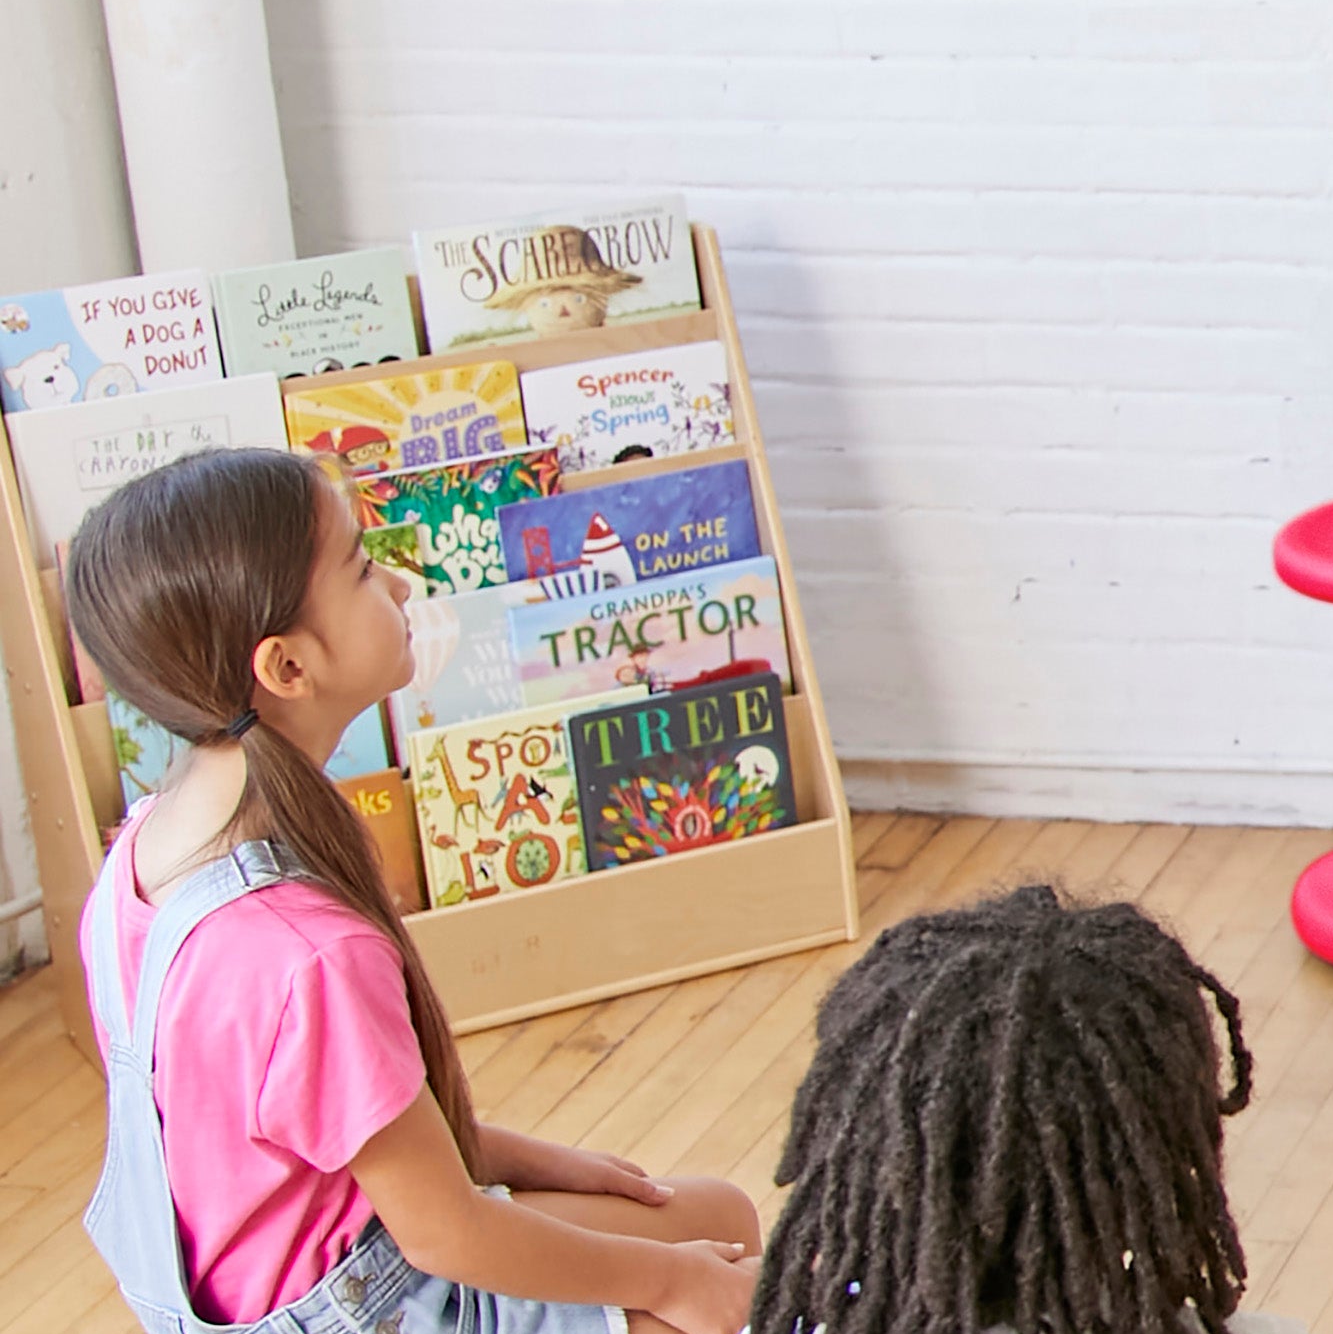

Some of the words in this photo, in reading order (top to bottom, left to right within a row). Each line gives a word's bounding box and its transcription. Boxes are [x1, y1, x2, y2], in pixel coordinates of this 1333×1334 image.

[434, 240, 471, 267] THE
[460, 215, 674, 302] SCARECROW
[82, 299, 101, 323] IF
[108, 295, 146, 317] YOU
[152, 288, 201, 310] GIVE
[313, 270, 382, 312] Legends
[125, 328, 136, 349] A
[142, 321, 185, 344] DOG
[193, 317, 203, 339] A
[144, 345, 207, 375] DONUT
[577, 368, 674, 398] Spencer
[411, 401, 477, 433] Dream
[591, 403, 670, 437] Spring
[401, 414, 505, 468] BIG
[635, 531, 669, 552] ON
[680, 517, 728, 544] THE
[639, 543, 730, 576] LAUNCH
[590, 582, 707, 621] GRANDPA'S
[539, 594, 760, 668] TRACTOR
[582, 686, 775, 769] TREE
